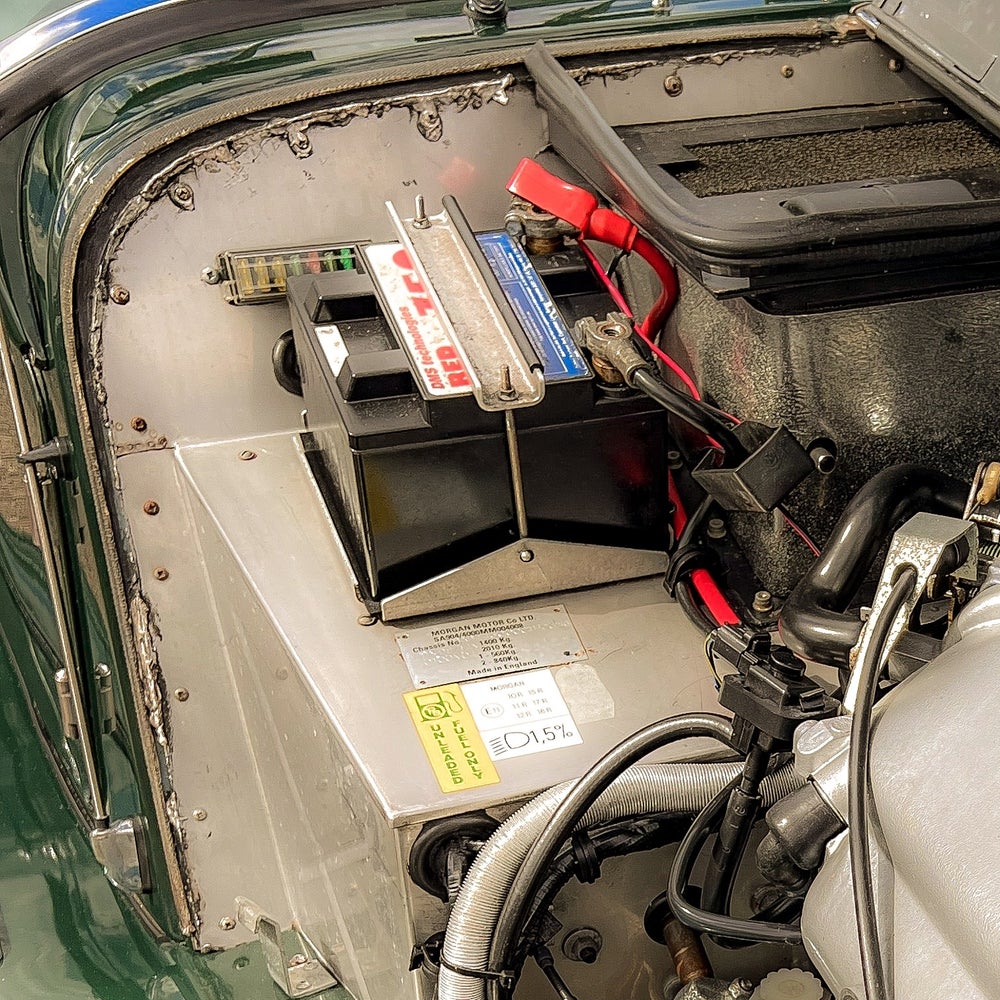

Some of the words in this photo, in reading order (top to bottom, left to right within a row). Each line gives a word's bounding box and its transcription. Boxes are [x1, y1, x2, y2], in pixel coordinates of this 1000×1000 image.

[399, 306, 435, 365] technologies
[435, 345, 472, 388] RED
[422, 366, 446, 390] DMS
[431, 624, 471, 637] MORGAN
[472, 619, 505, 630] MOTOR
[518, 614, 534, 623] LTD
[412, 643, 446, 653] Chassis
[479, 638, 498, 646] 1400
[499, 636, 511, 644] Kg
[501, 642, 514, 650] Kg
[467, 667, 492, 676] Made
[504, 659, 538, 670] England
[490, 680, 525, 692] MORGAN
[529, 723, 574, 745] 1,5%
[430, 724, 464, 785] UNLEADED
[452, 721, 471, 749] FUEL
[464, 751, 485, 781] ONLY
